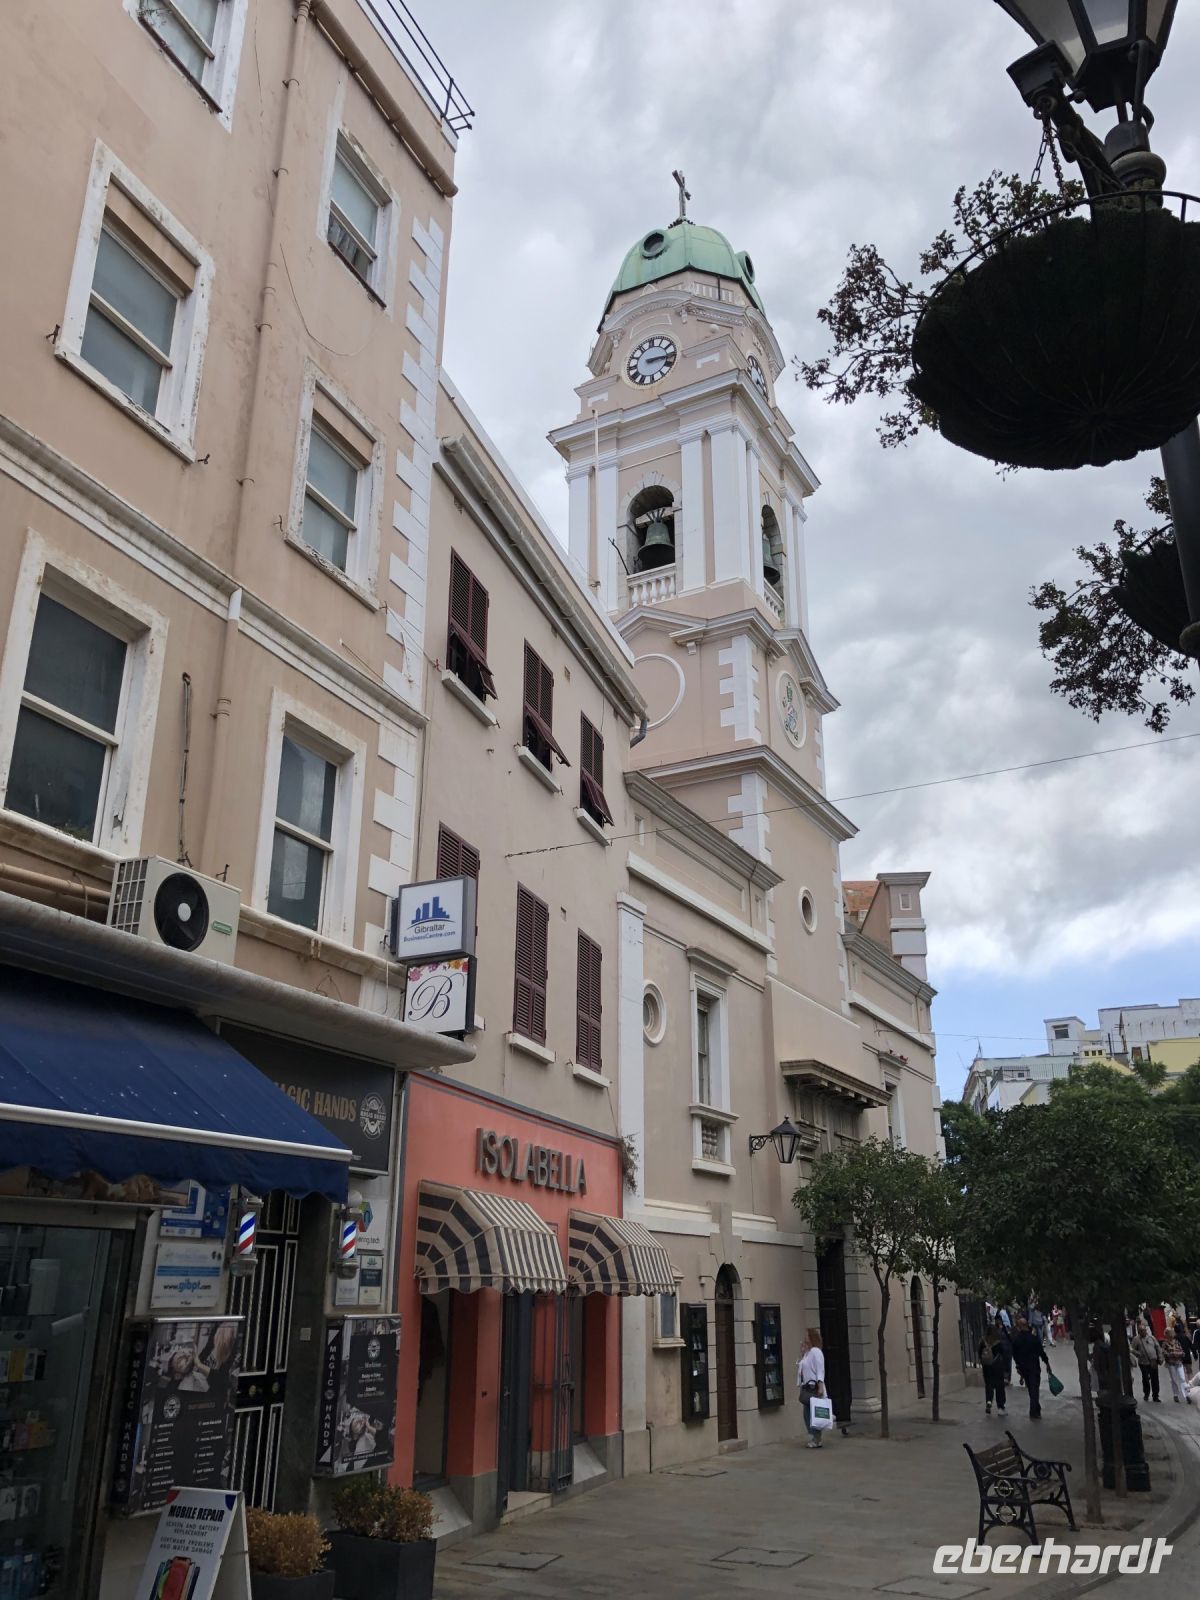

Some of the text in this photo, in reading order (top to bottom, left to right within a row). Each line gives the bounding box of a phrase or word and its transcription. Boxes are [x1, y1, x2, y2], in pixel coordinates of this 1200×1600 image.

[403, 930, 456, 943] BusinessCentre.com
[414, 923, 446, 935] Gibraltar
[407, 972, 466, 1022] B
[274, 1082, 357, 1123] GIC HANDS
[476, 1127, 587, 1195] ISOLABELLA
[323, 1345, 337, 1447] MAGIC HANDS
[168, 1504, 198, 1520] MOBILE
[197, 1507, 225, 1522] REPAIR
